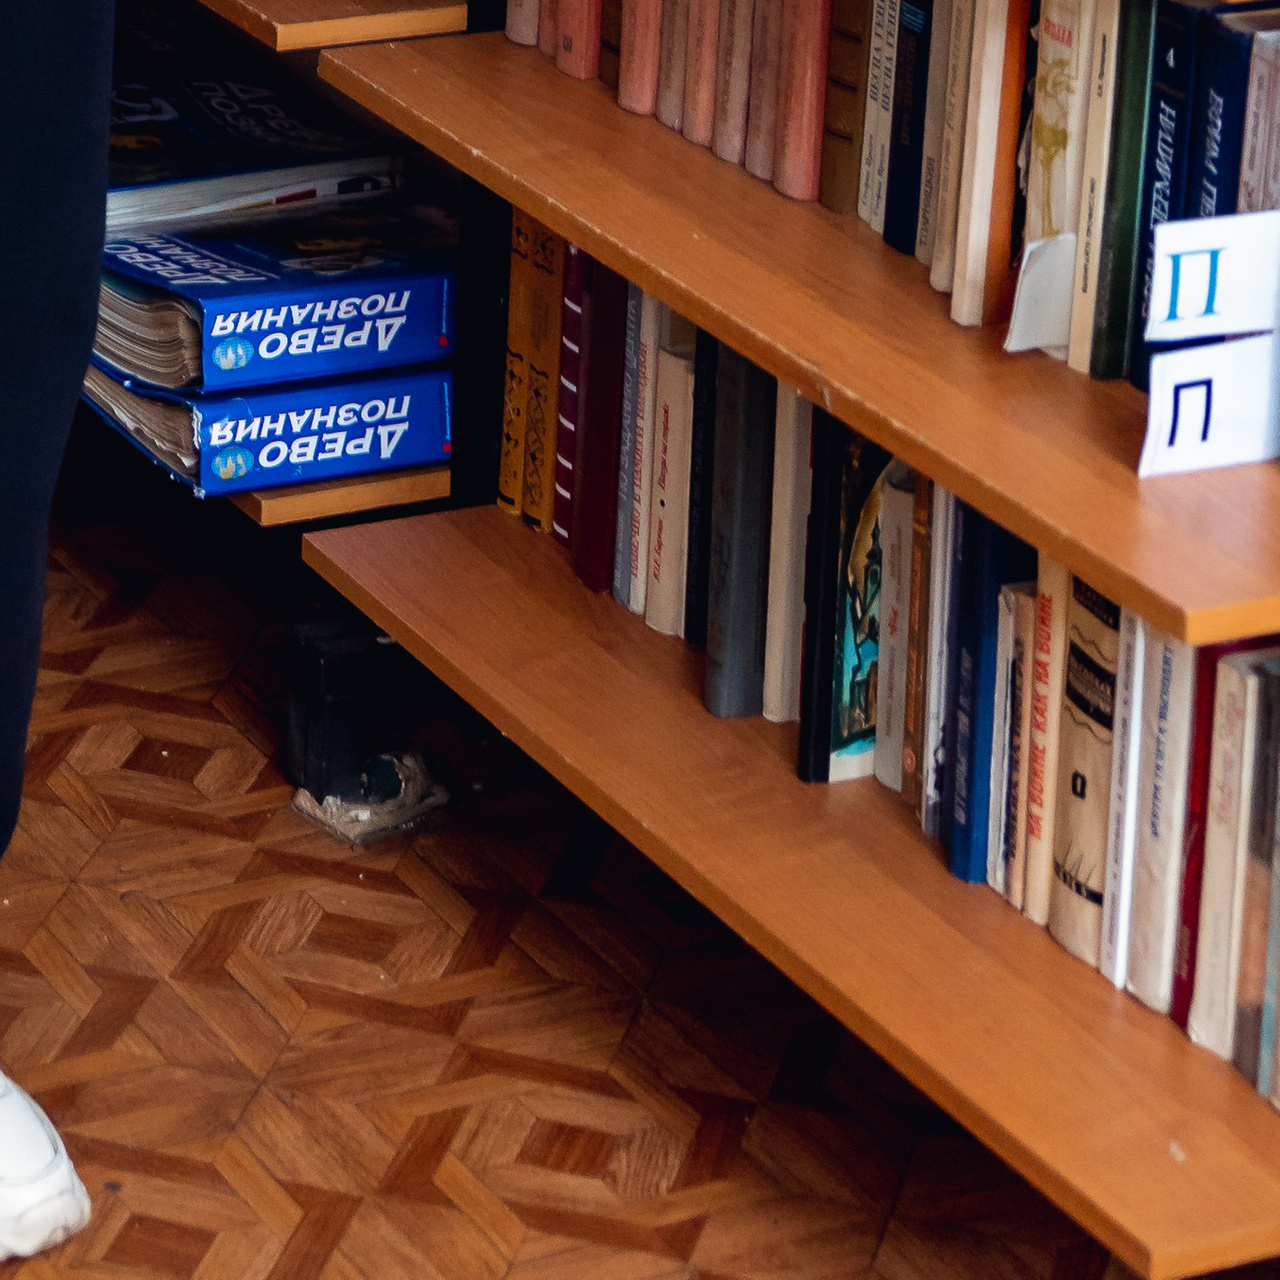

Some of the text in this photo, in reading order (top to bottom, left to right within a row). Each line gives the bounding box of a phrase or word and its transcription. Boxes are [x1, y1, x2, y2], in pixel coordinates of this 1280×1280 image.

[869, 45, 883, 102] ВЕСНА
[880, 55, 893, 112] ВЕСНА
[1164, 247, 1227, 322] П
[210, 290, 411, 337] ПОЗНАНИЯ
[258, 315, 408, 359] ДРЕВО
[209, 395, 411, 446] ПОЗНАНИЯ
[1167, 378, 1213, 447] П
[258, 421, 410, 469] ДРЕВО
[1028, 592, 1053, 840] НА ВОЙНЕ КАК НА ВОЙНЕ
